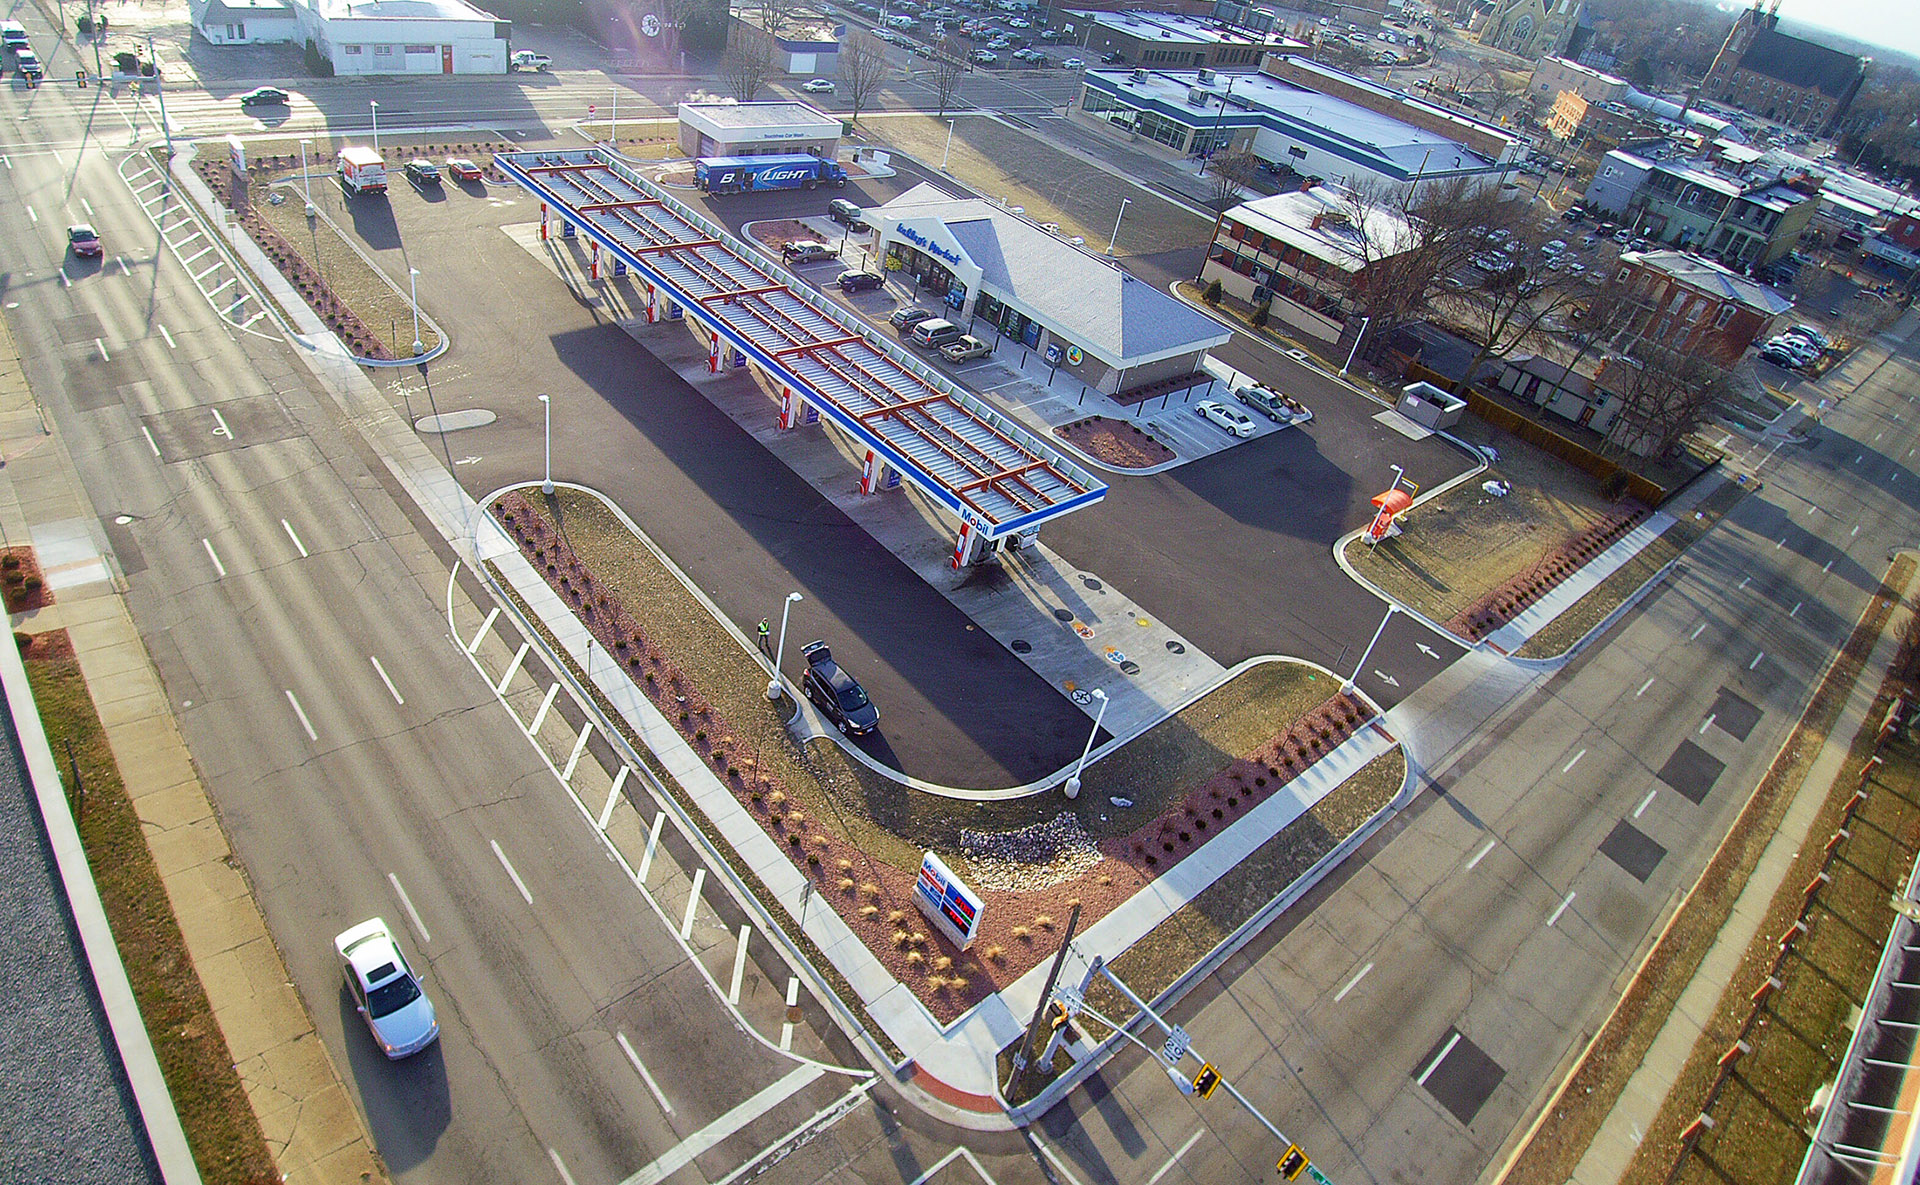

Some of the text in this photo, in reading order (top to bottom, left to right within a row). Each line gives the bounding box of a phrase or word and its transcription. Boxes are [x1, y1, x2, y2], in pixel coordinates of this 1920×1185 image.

[763, 170, 809, 181] LIGHT
[928, 240, 962, 266] Market
[961, 508, 989, 536] Mobil
[923, 861, 946, 886] Mobil
[1166, 1041, 1182, 1055] 20
